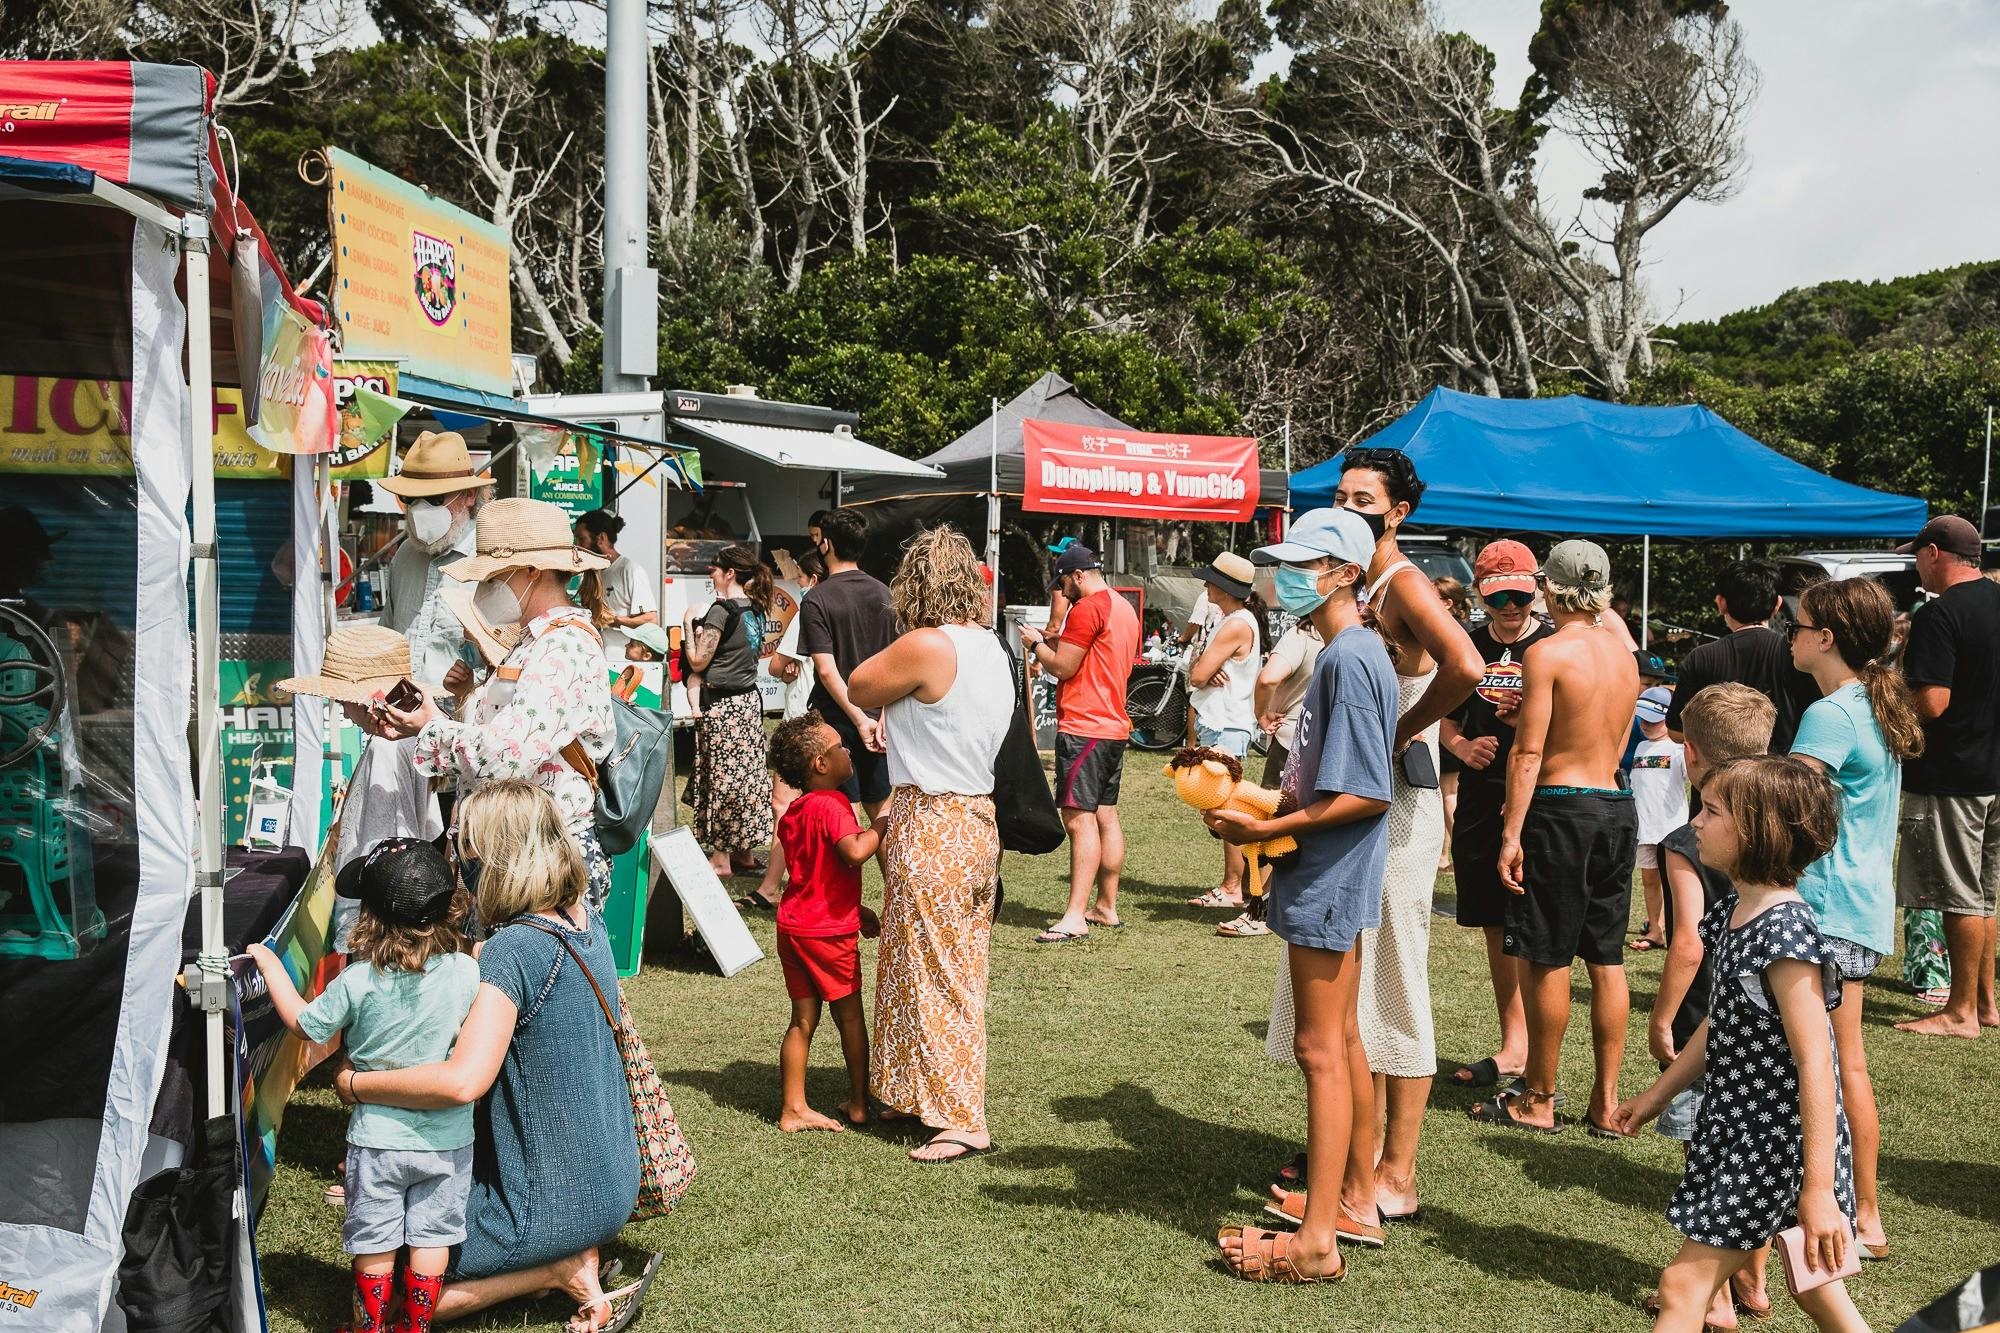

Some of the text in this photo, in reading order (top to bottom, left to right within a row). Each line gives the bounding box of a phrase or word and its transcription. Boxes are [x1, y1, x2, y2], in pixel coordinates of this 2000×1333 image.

[0, 101, 60, 120] rail
[678, 399, 699, 412] XTM
[1082, 434, 1110, 453] 饺子
[1164, 442, 1192, 459] 饺子
[213, 445, 259, 471] juice
[1041, 460, 1246, 500] Dumpling & YumCha
[552, 483, 585, 492] JUICES
[541, 491, 594, 501] ANY COMBINATION
[1478, 676, 1523, 688] Dickie
[1540, 787, 1577, 797] BONDS
[5, 1303, 19, 1313] 3.0
